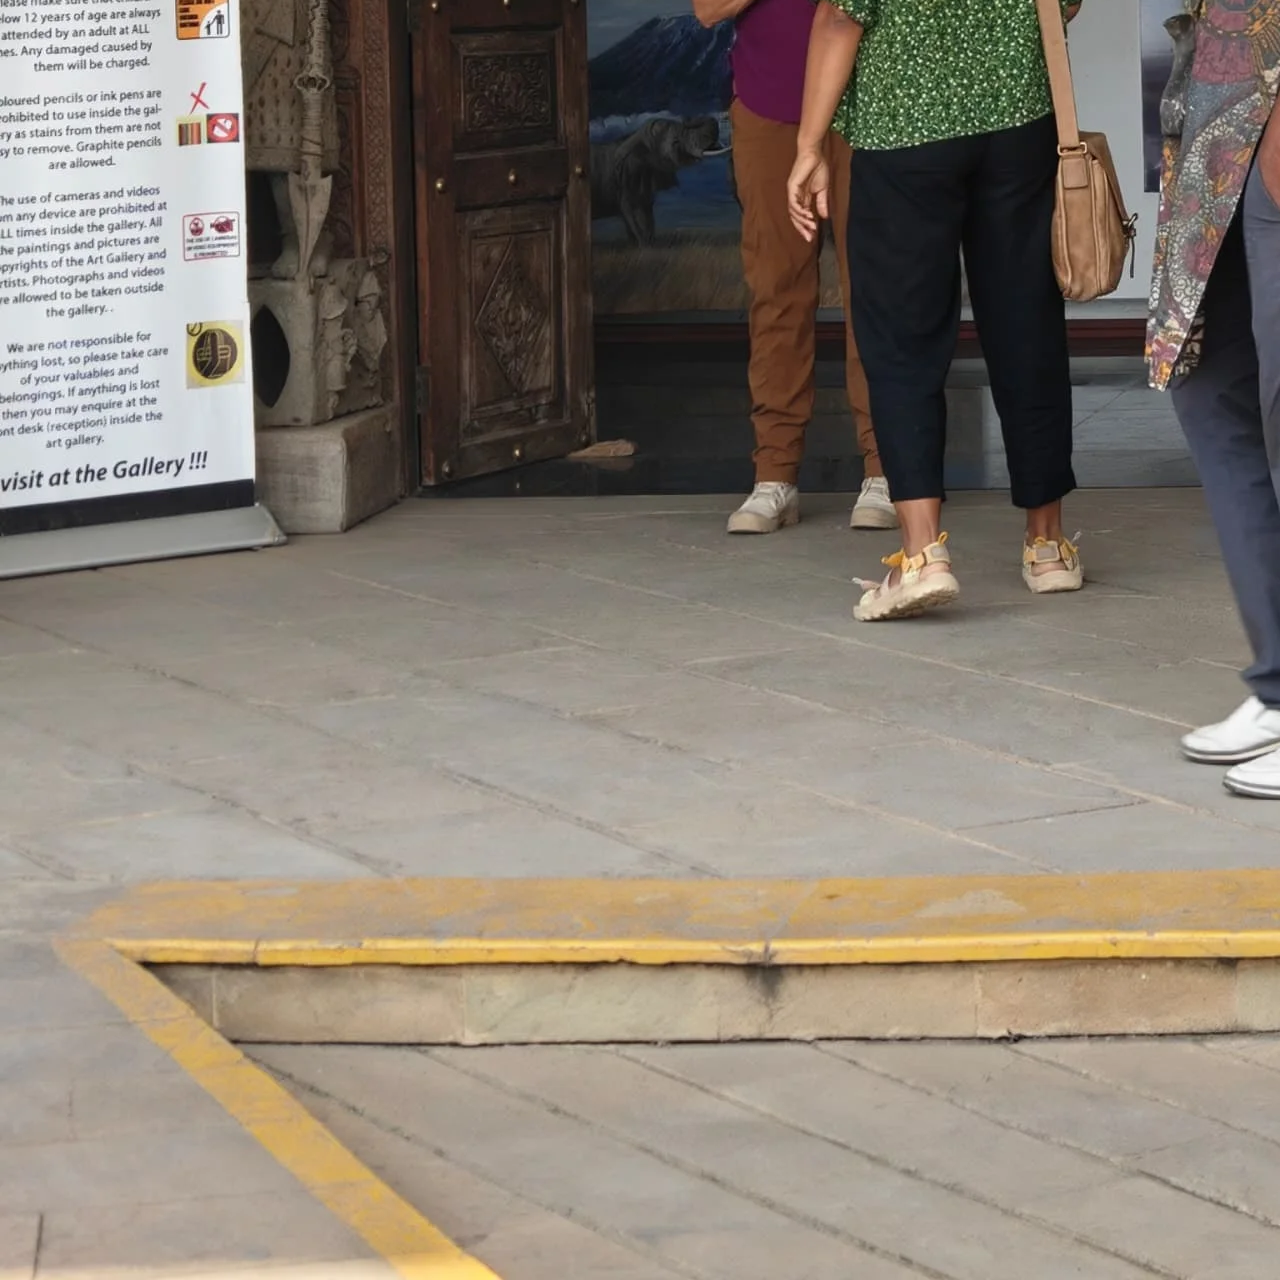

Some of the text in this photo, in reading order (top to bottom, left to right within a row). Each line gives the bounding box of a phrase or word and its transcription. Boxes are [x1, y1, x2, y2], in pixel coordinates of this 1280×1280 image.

[40, 8, 161, 24] years age are always
[88, 25, 117, 37] adult
[131, 23, 150, 34] ALL
[20, 40, 138, 58] Any damaged caused
[34, 56, 150, 72] them will charged.
[43, 90, 162, 107] pencils ink pens are
[67, 103, 162, 120] use inside the gal-
[29, 121, 161, 138] stains from them are not
[27, 136, 162, 154] remove. Graphite pencils
[48, 156, 116, 170] are allowed.
[54, 185, 160, 202] cameras and videos
[15, 201, 155, 223] any device are prohibited
[16, 216, 162, 238] times inside the gallery. All
[17, 235, 160, 256] paintings and pictures are
[65, 248, 167, 267] the Art Gallery and
[32, 266, 165, 286] Photographs and videos
[12, 281, 164, 304] allowed taken outside
[46, 307, 64, 318] the
[27, 331, 151, 352] are not responsible for
[41, 347, 168, 367] lost, please take care
[35, 363, 138, 386] your valuables and
[78, 379, 159, 397] anything lost
[2, 395, 157, 420] then you may enquire the
[17, 410, 163, 435] desk (reception) inside the
[46, 434, 104, 449] art gallery.
[48, 468, 71, 487] at
[75, 464, 107, 483] the
[112, 457, 185, 478] Gallery
[188, 450, 208, 470] !!!
